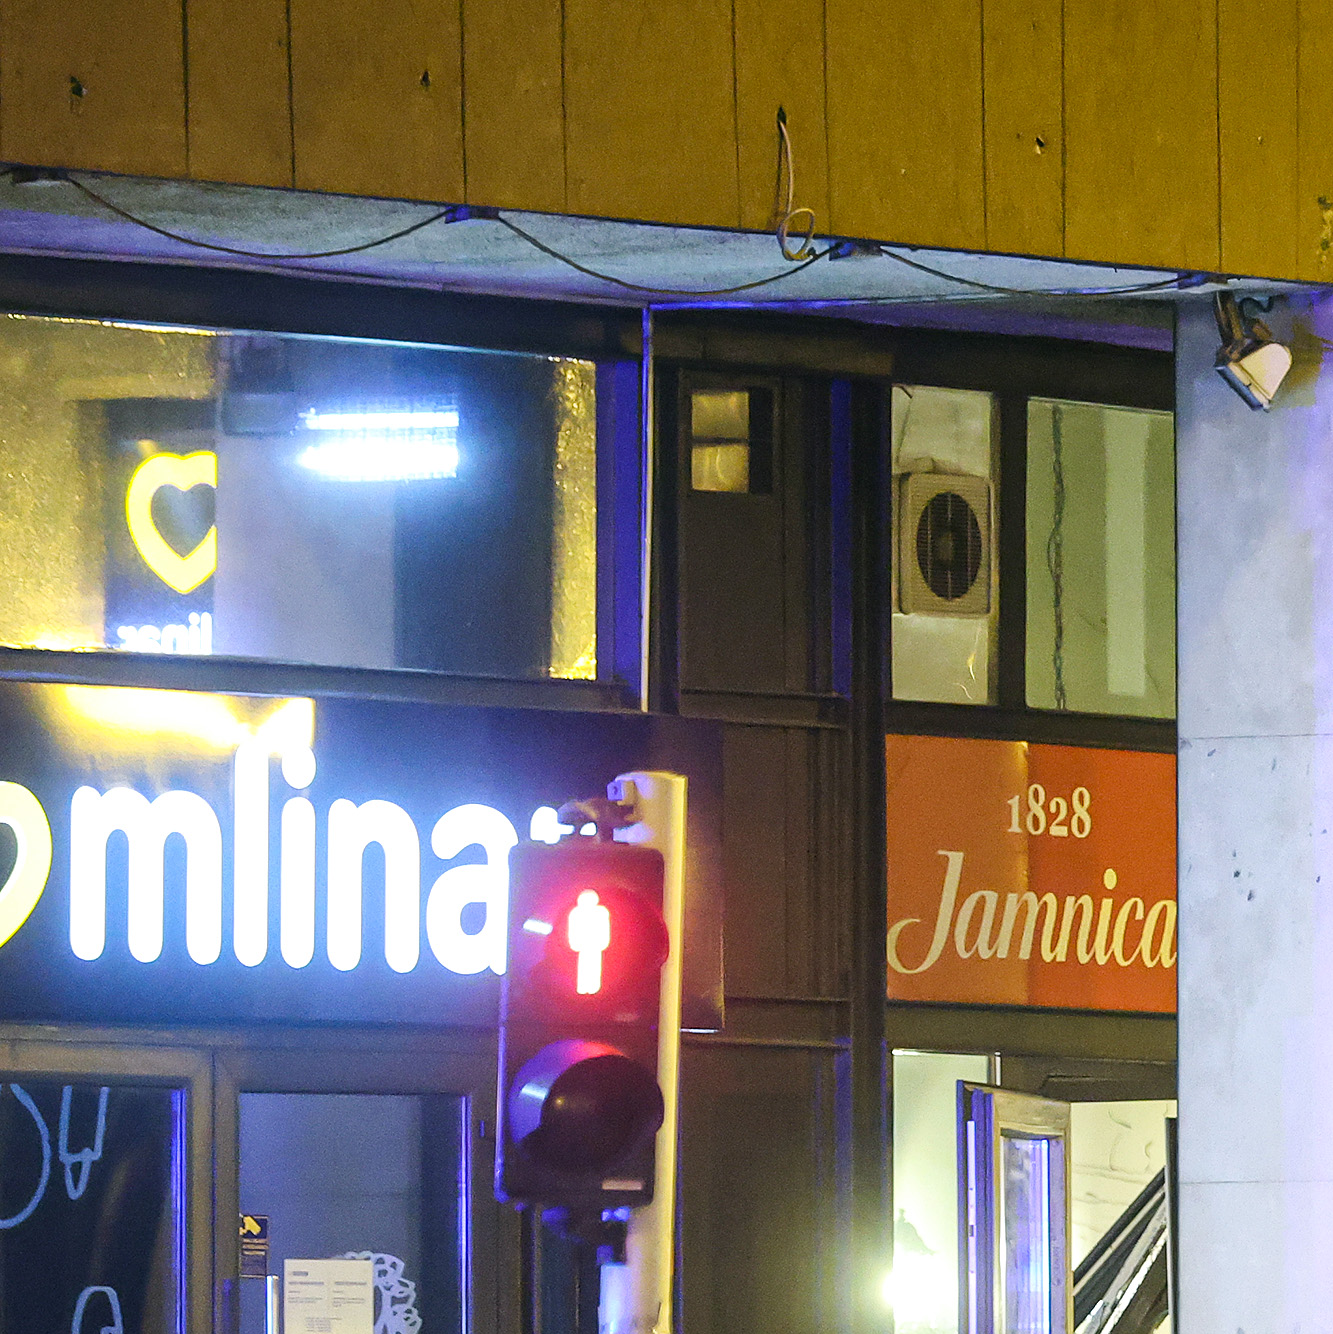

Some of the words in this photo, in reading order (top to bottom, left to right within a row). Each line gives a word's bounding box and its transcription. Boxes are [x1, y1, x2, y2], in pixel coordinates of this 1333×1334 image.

[69, 741, 597, 976] mlina
[1006, 783, 1093, 839] 1828
[886, 849, 1178, 974] Jamnica
